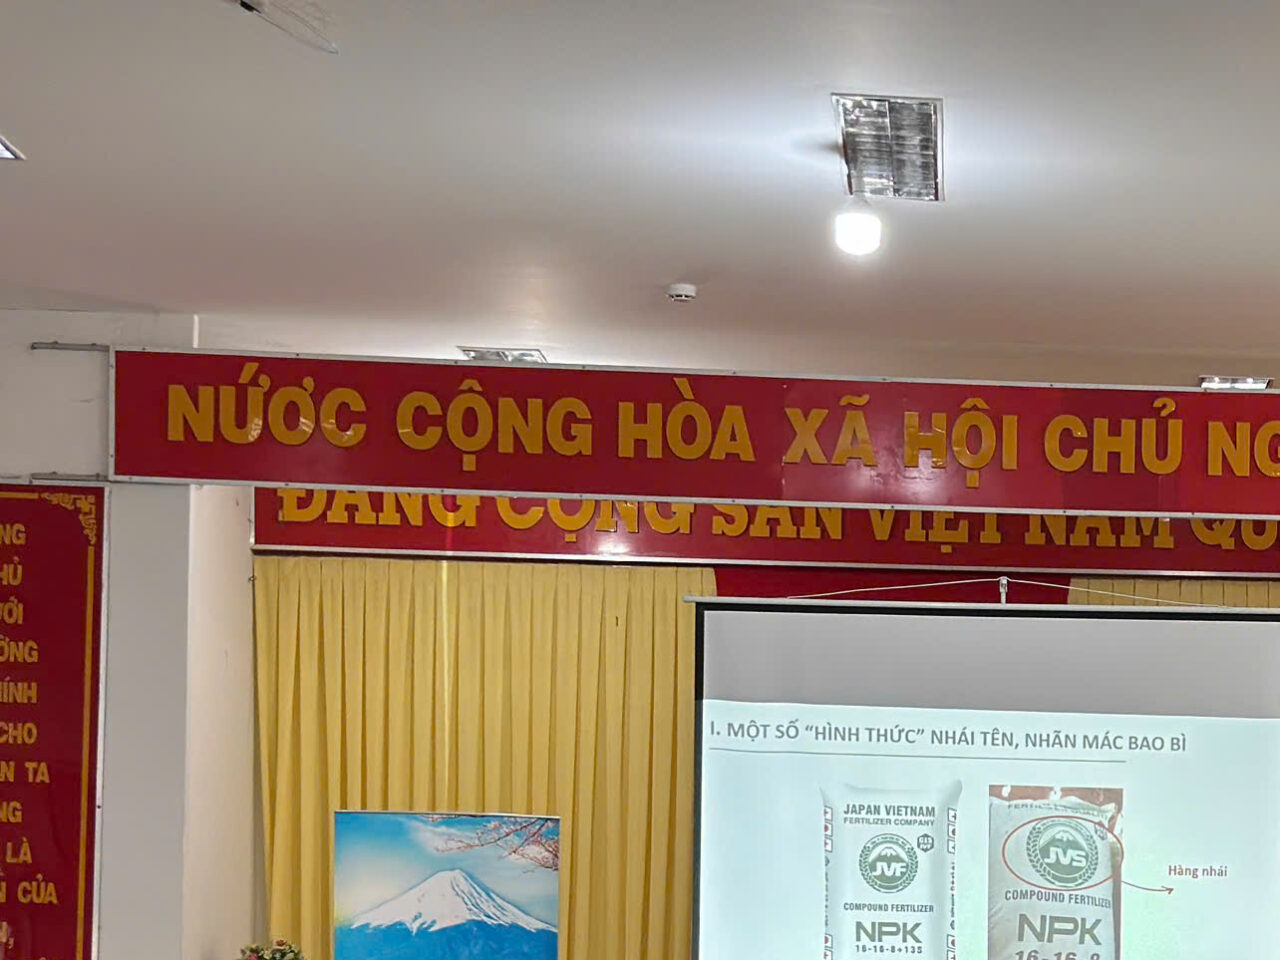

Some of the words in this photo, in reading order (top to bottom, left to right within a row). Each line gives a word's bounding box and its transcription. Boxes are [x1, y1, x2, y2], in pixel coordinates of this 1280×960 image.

[398, 380, 593, 471] CỘNG
[617, 377, 755, 463] HÒA
[782, 394, 878, 467] XÃ
[903, 397, 1018, 488] HỘI
[1044, 397, 1184, 475] CHỦ
[727, 720, 771, 742] MỘT
[775, 719, 799, 740] SỐ
[804, 722, 860, 742] “HÌNH
[865, 724, 925, 744] THỨC”
[931, 724, 975, 746] NHÁI
[980, 728, 1020, 749] TÊN,
[1025, 730, 1077, 749] NHÃN
[1082, 731, 1124, 750] MÁC
[1128, 734, 1165, 751] BAO
[1170, 733, 1187, 752] BÌ
[25, 761, 50, 783] TA
[844, 804, 881, 816] JAPAN
[885, 805, 935, 817] VIETNAM
[844, 816, 892, 826] FERTILIZER
[894, 818, 935, 827] COMPANY
[6, 836, 32, 864] LÀ
[1043, 846, 1087, 867] JVS
[873, 862, 907, 877] JVF
[1168, 865, 1198, 880] Hàng
[1202, 865, 1228, 877] nhái
[18, 873, 58, 904] CỦA
[1005, 889, 1065, 903] COMPOUND
[843, 902, 889, 912] COMPOUND
[891, 904, 934, 912] FERTILIZER
[856, 921, 923, 943] NPK
[1018, 914, 1102, 945] NPK
